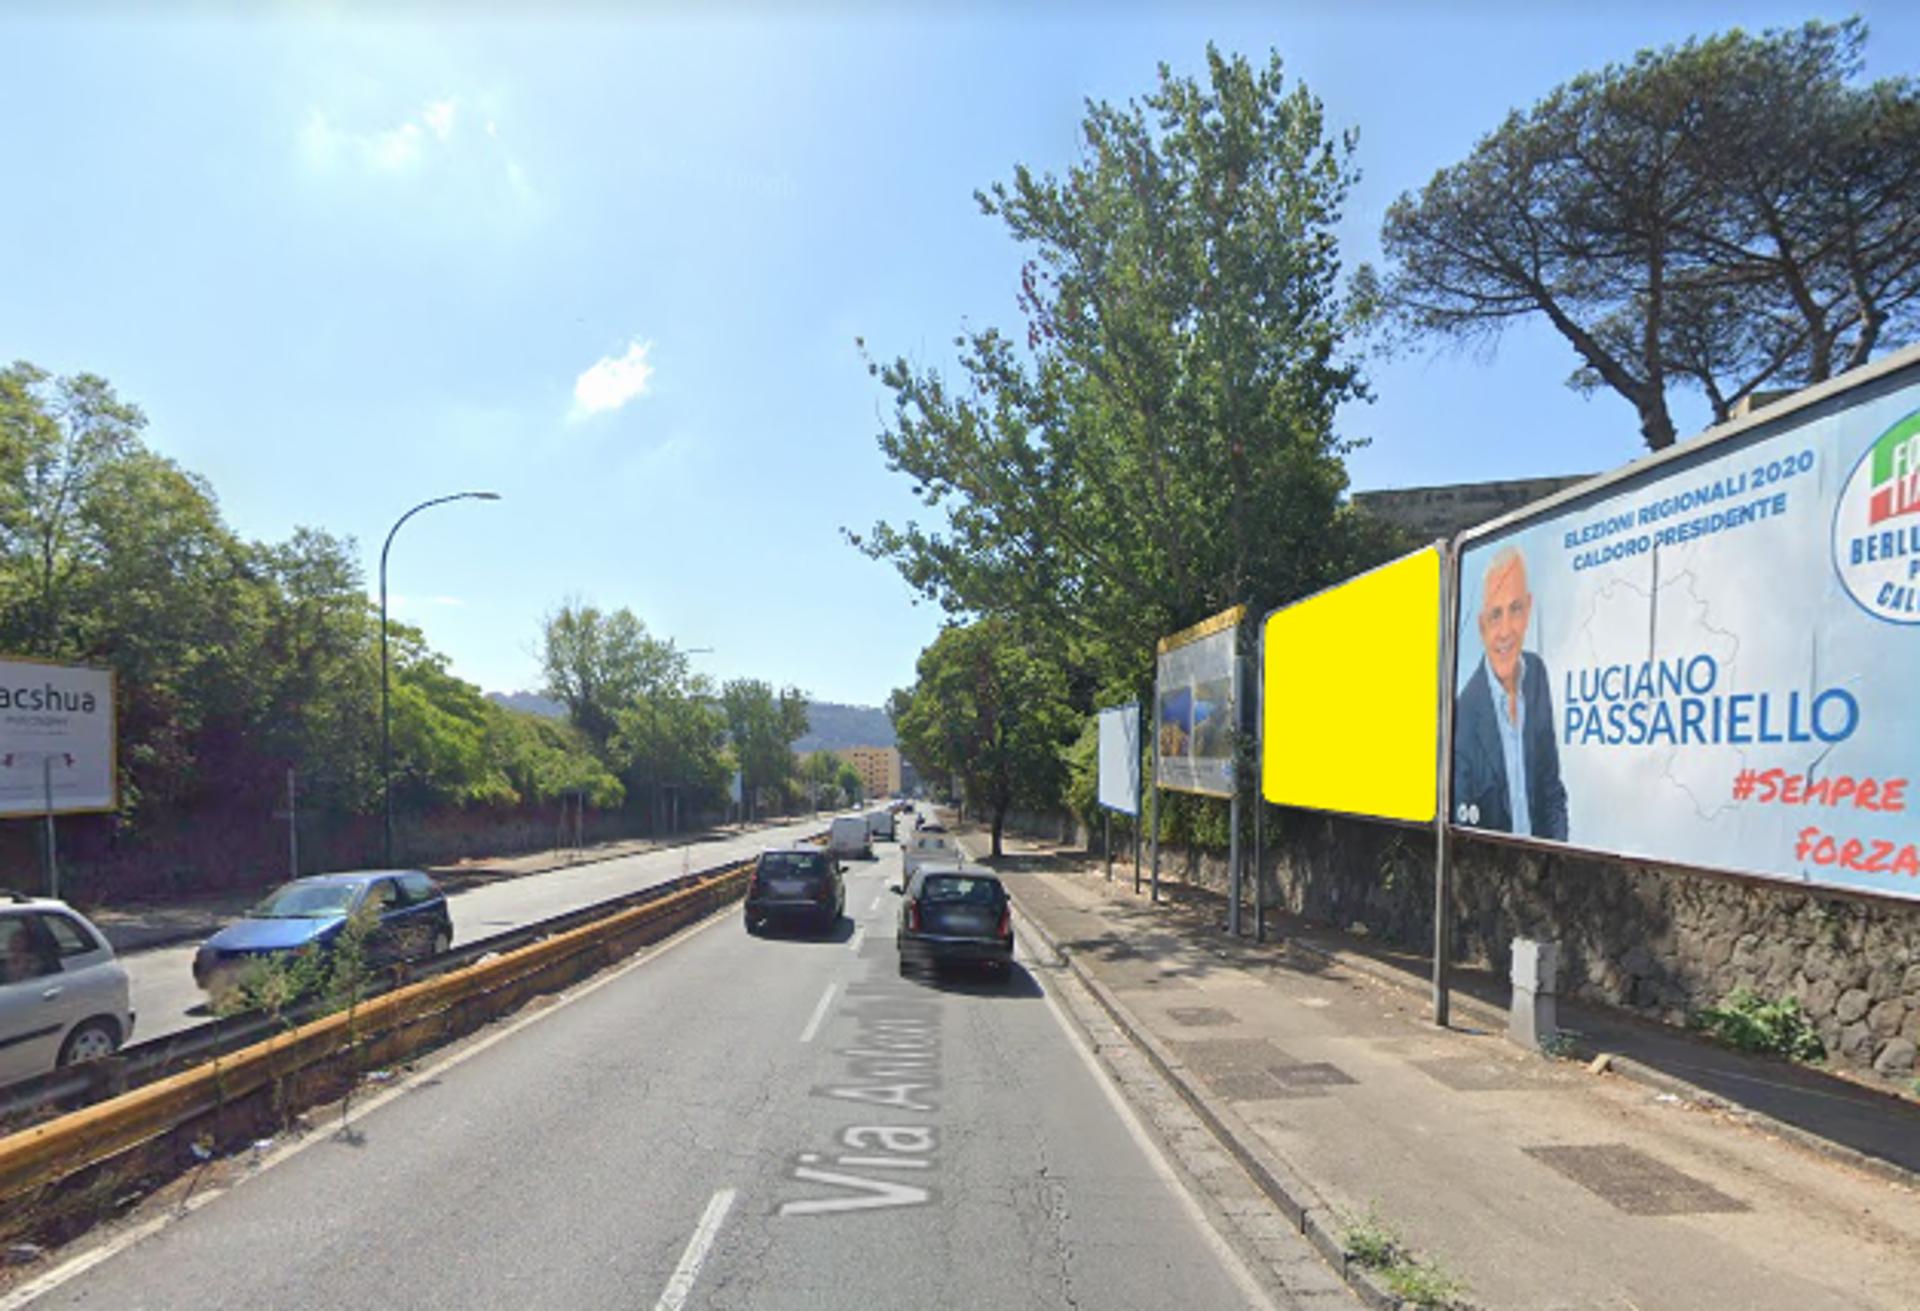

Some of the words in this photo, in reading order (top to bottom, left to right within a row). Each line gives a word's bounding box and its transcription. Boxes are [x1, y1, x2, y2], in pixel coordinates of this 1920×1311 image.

[1564, 511, 1635, 549] ELEZIONI
[1638, 473, 1746, 525] REGIONALI
[1751, 450, 1815, 490] 2020
[1573, 535, 1650, 571] CALDORO
[1654, 493, 1787, 546] PRESIDENTE
[1566, 654, 1717, 703] LUCIANO
[1564, 688, 1860, 745] PASSARIELLO
[1732, 768, 1910, 813] #SEMPRE
[1794, 826, 1920, 877] FORZA
